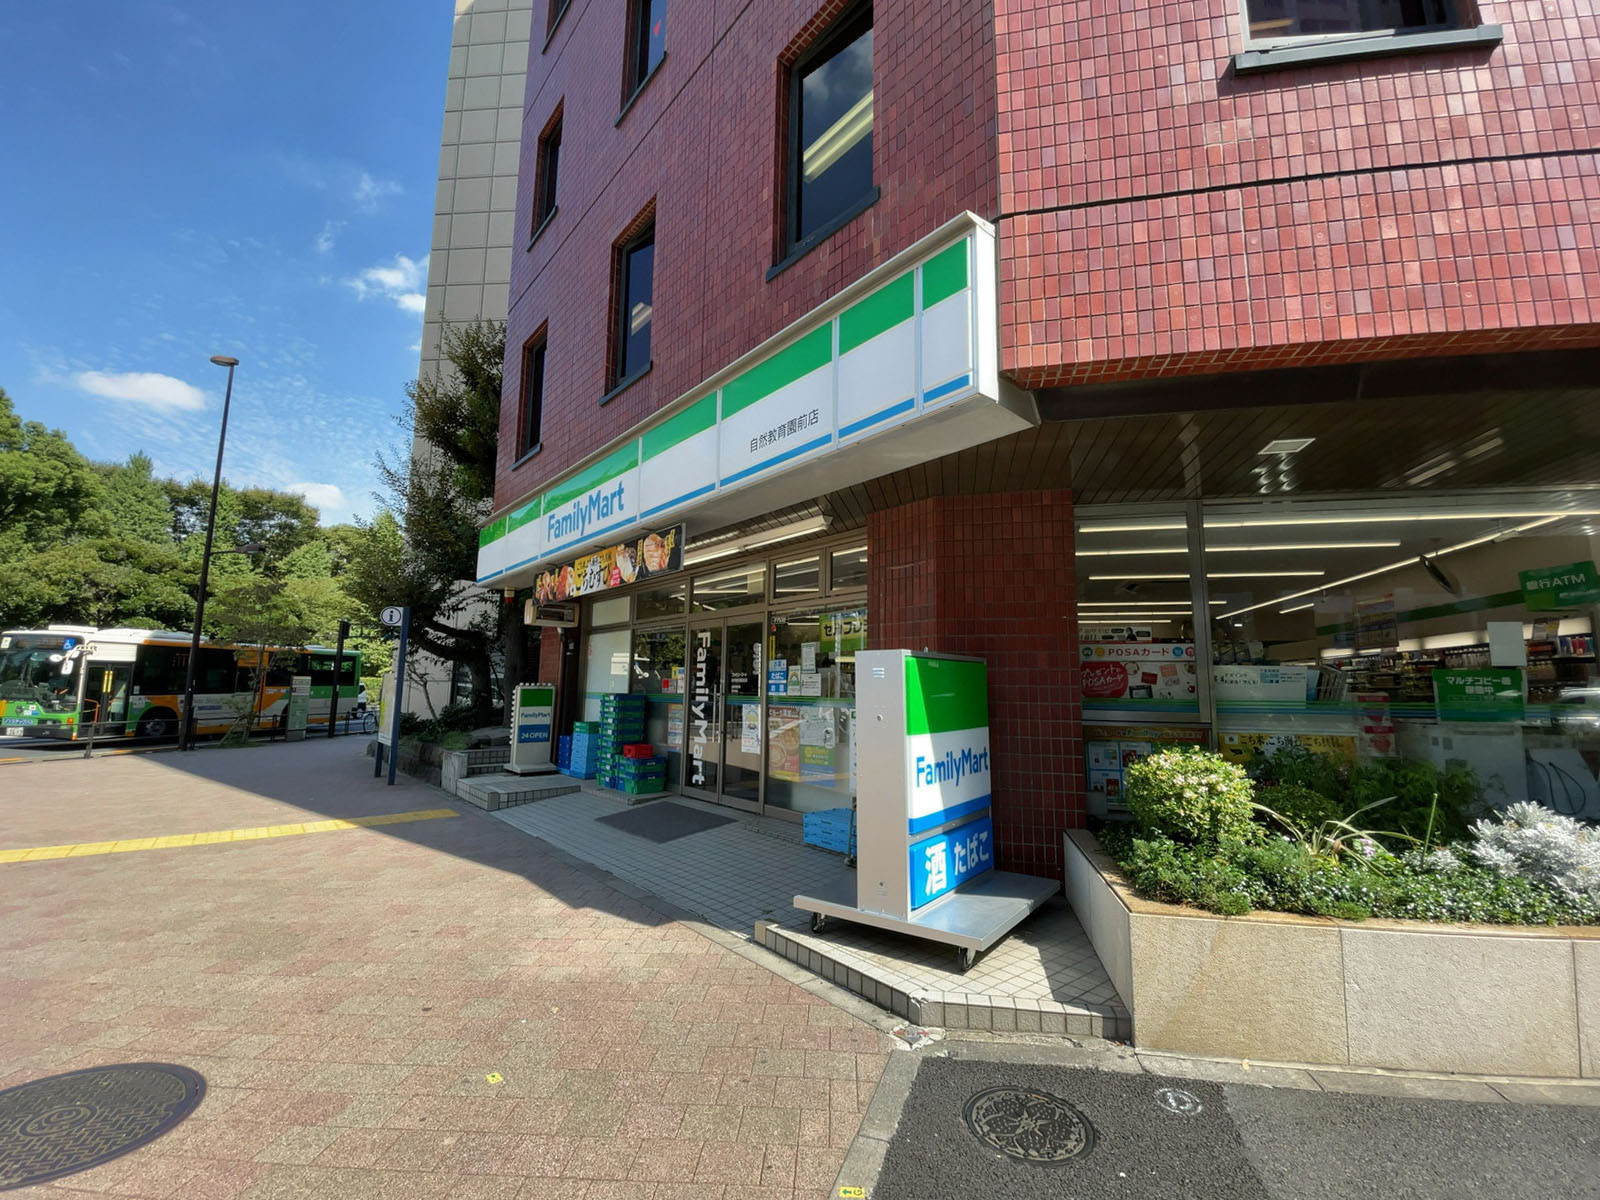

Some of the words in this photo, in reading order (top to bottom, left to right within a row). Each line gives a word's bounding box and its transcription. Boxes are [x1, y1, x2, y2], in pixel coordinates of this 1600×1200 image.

[750, 408, 819, 453] 自然教育園前店
[546, 480, 625, 543] FamilyMart
[1108, 647, 1170, 656] POSAカード
[521, 712, 551, 720] FamilyMart
[691, 631, 711, 786] FamilyMart
[915, 746, 989, 788] FamilyMart
[924, 840, 948, 897] 酒
[953, 831, 990, 877] たばこ
